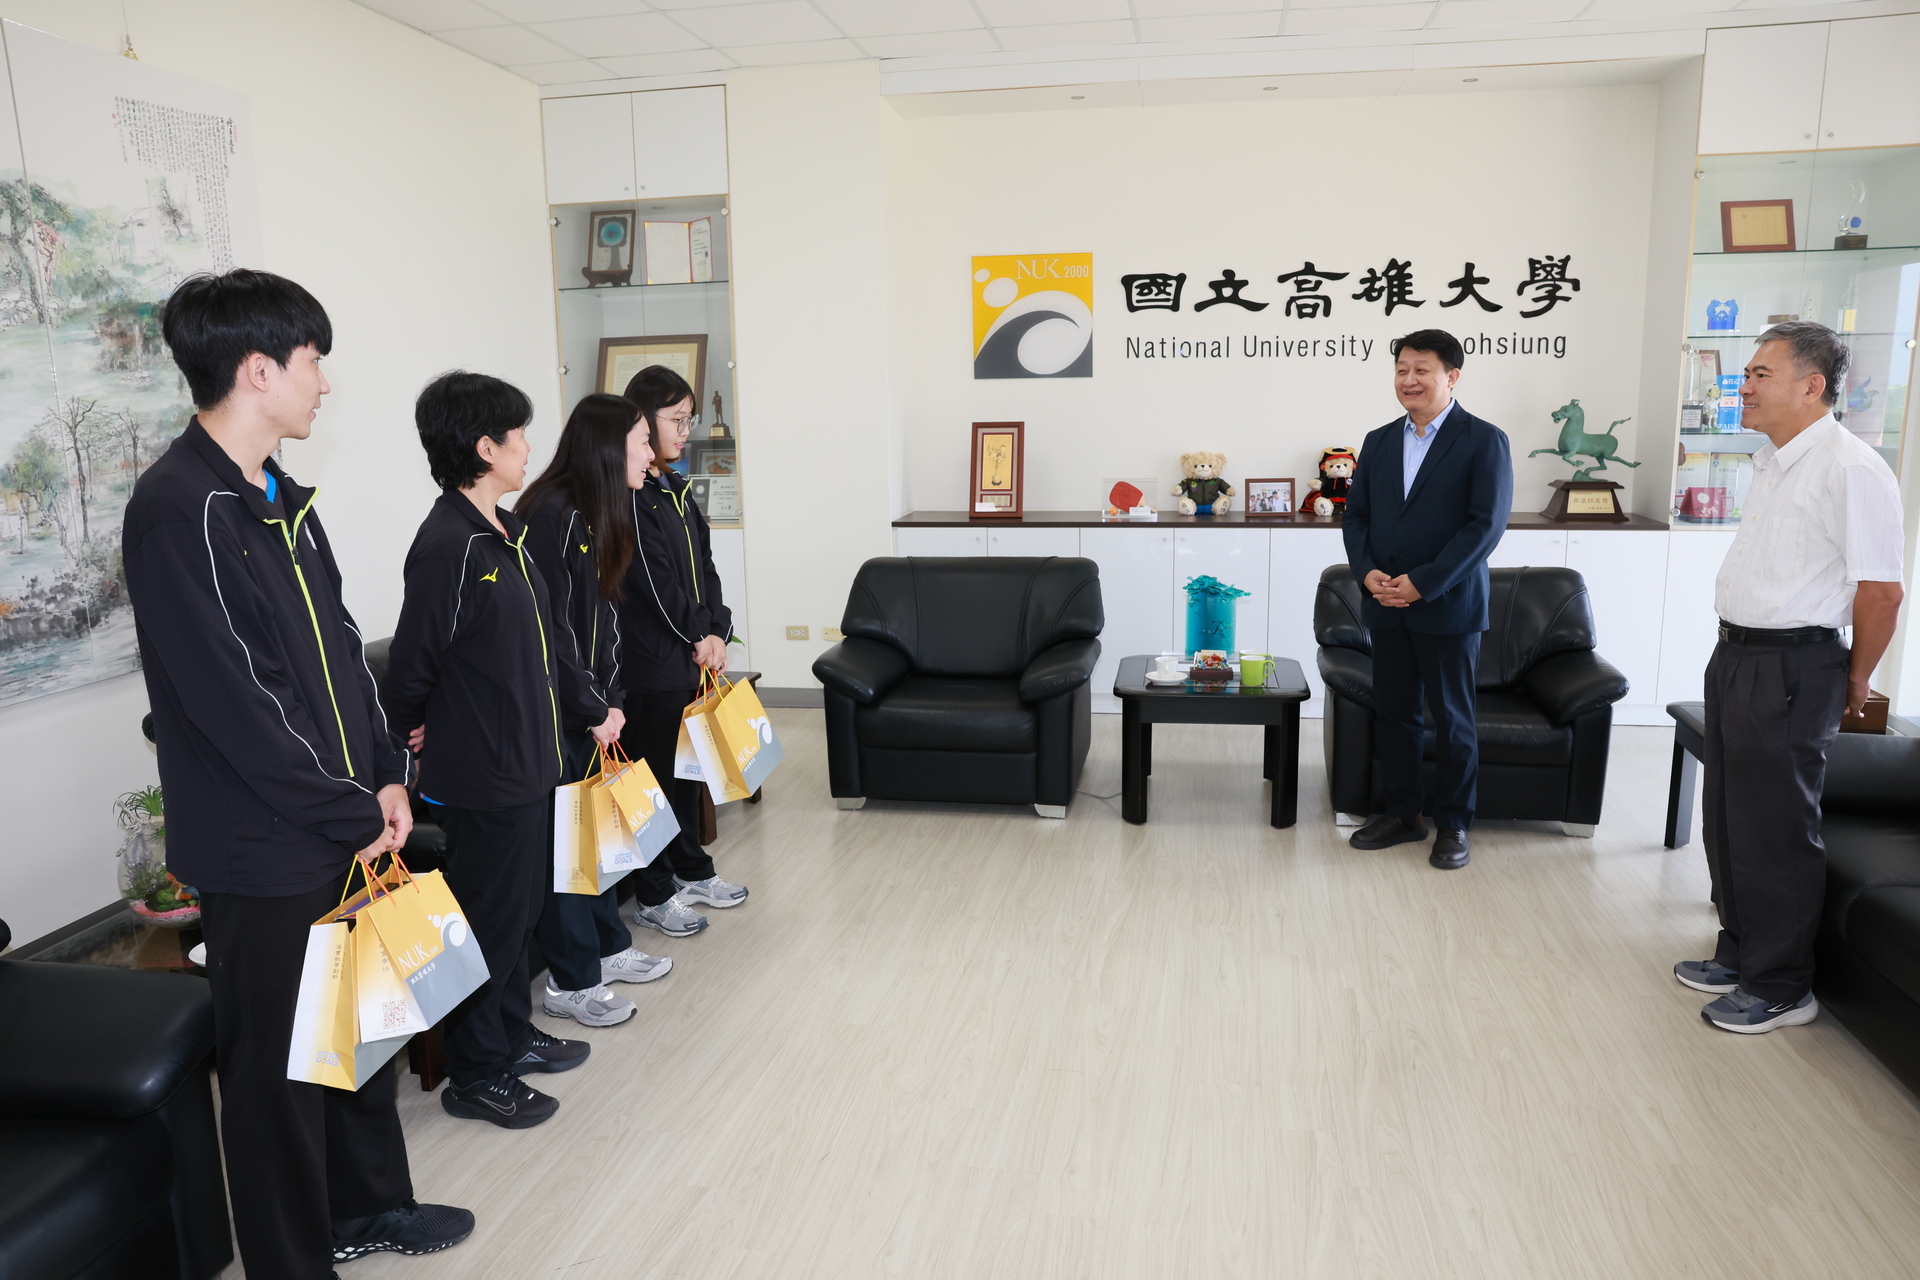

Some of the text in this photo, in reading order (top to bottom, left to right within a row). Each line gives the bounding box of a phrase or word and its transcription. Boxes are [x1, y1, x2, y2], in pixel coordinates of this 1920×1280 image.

[1016, 258, 1089, 280] NUK 2000
[1120, 255, 1581, 319] 國立高雄大學
[1126, 336, 1230, 358] National
[1243, 334, 1374, 361] University
[1463, 332, 1567, 359] ohsiung
[397, 941, 430, 973] NUK
